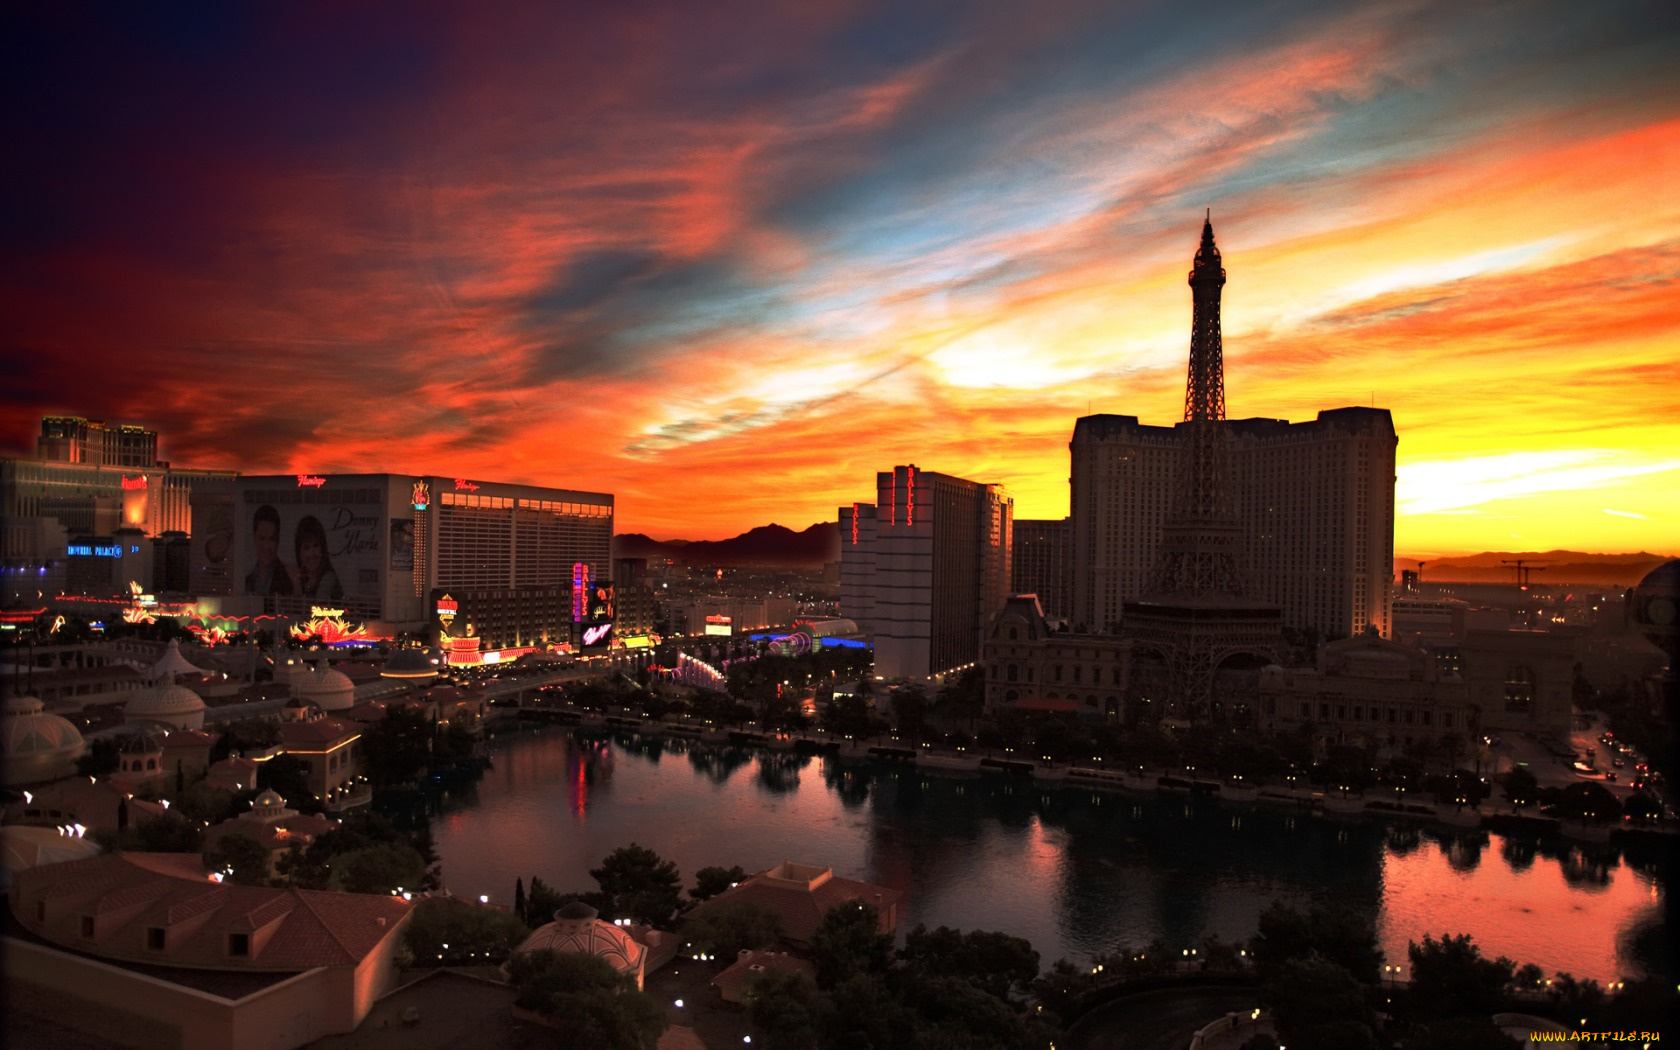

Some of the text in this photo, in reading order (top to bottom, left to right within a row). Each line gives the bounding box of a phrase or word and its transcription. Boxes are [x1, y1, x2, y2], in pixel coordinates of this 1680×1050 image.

[297, 475, 326, 488] Flamingo
[329, 506, 379, 530] Donny
[332, 530, 379, 556] Marie
